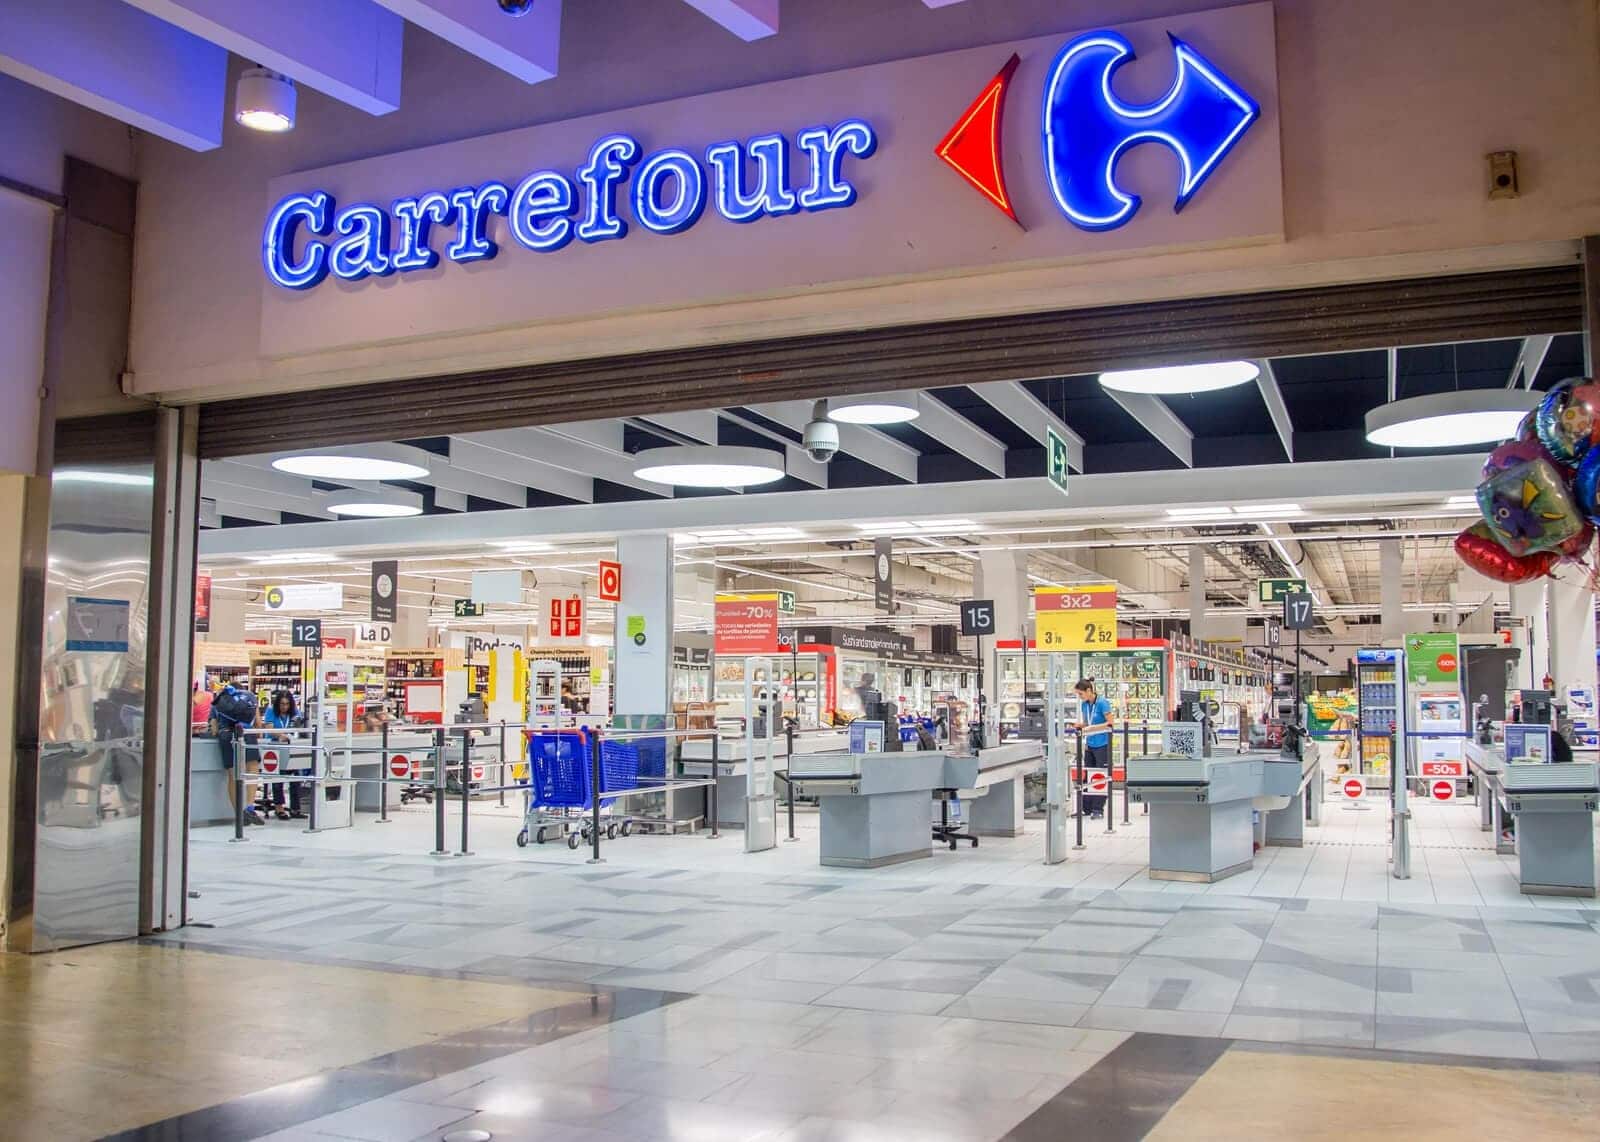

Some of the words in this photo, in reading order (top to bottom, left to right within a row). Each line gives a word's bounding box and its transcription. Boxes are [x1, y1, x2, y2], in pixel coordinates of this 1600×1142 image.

[263, 118, 876, 290] Carrefour
[1060, 594, 1092, 608] 3x2
[741, 606, 774, 619] -70%
[967, 607, 991, 628] 15
[1292, 601, 1310, 622] 17
[296, 625, 317, 641] 12
[361, 624, 376, 641] La
[1045, 631, 1053, 644] 3
[1084, 623, 1096, 643] 2
[1098, 631, 1112, 643] 52
[1270, 626, 1279, 643] 16
[1426, 763, 1457, 775] -50%
[1132, 793, 1142, 802] 16
[1196, 793, 1206, 802] 17
[1511, 802, 1522, 811] 18
[1584, 801, 1596, 811] 19
